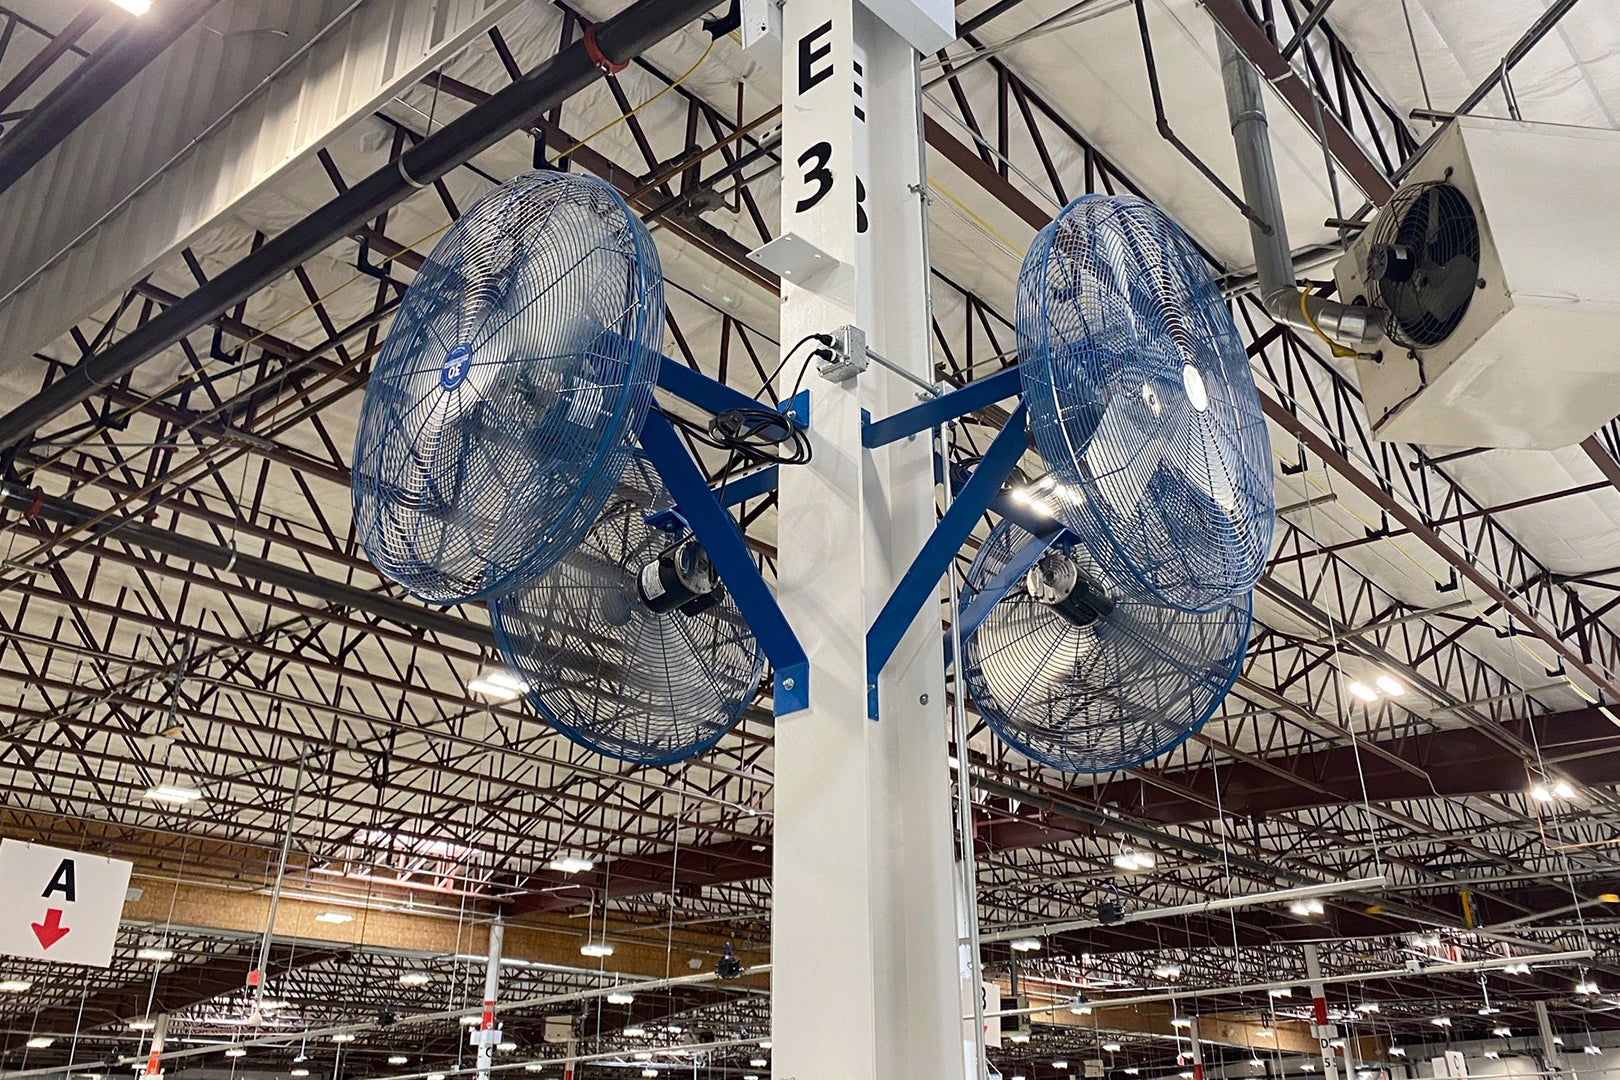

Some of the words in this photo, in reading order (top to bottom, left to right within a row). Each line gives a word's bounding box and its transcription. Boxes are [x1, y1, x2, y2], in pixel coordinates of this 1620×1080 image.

[798, 19, 834, 96] E
[795, 141, 834, 213] 3
[448, 363, 462, 380] 30
[41, 858, 76, 902] A
[1321, 1038, 1329, 1049] D
